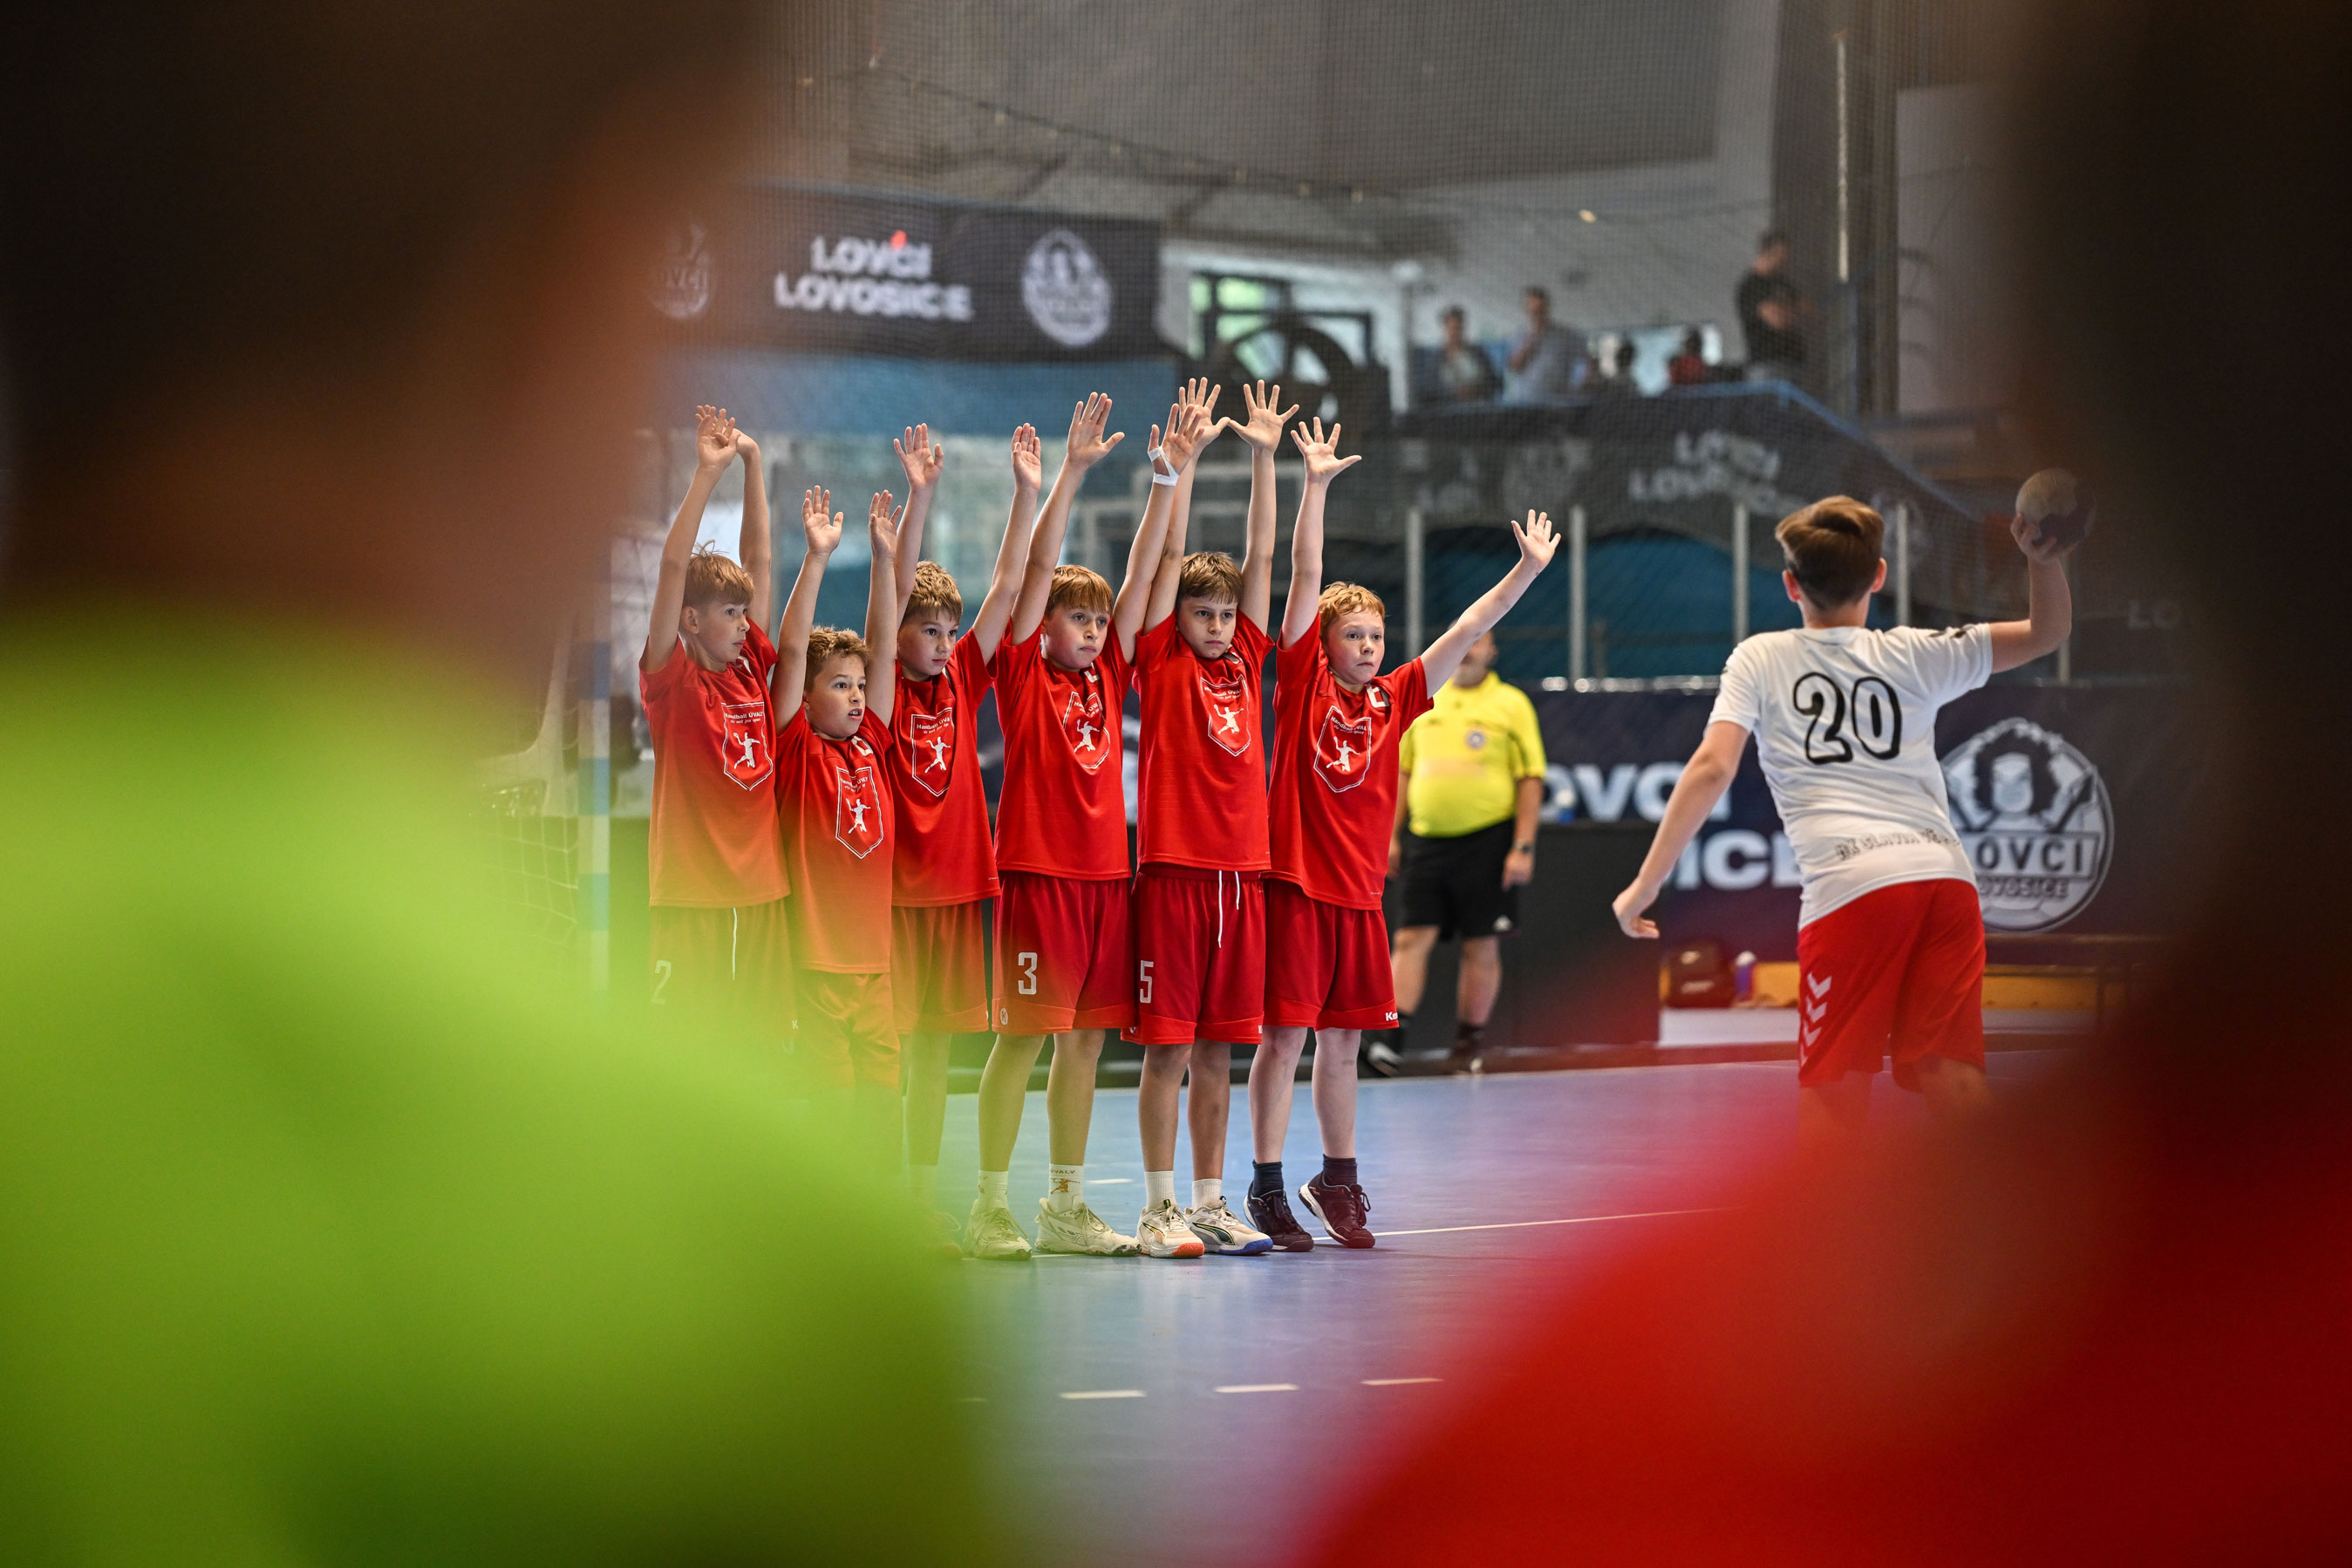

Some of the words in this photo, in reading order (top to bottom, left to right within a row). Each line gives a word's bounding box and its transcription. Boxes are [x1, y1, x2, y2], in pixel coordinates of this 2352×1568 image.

[773, 271, 975, 323] LOVOSICE
[1794, 672, 1902, 765] 20
[1976, 834, 2084, 873] OVCI
[651, 959, 672, 1006] 2
[1018, 951, 1038, 995] 3
[1139, 960, 1154, 1004] 5
